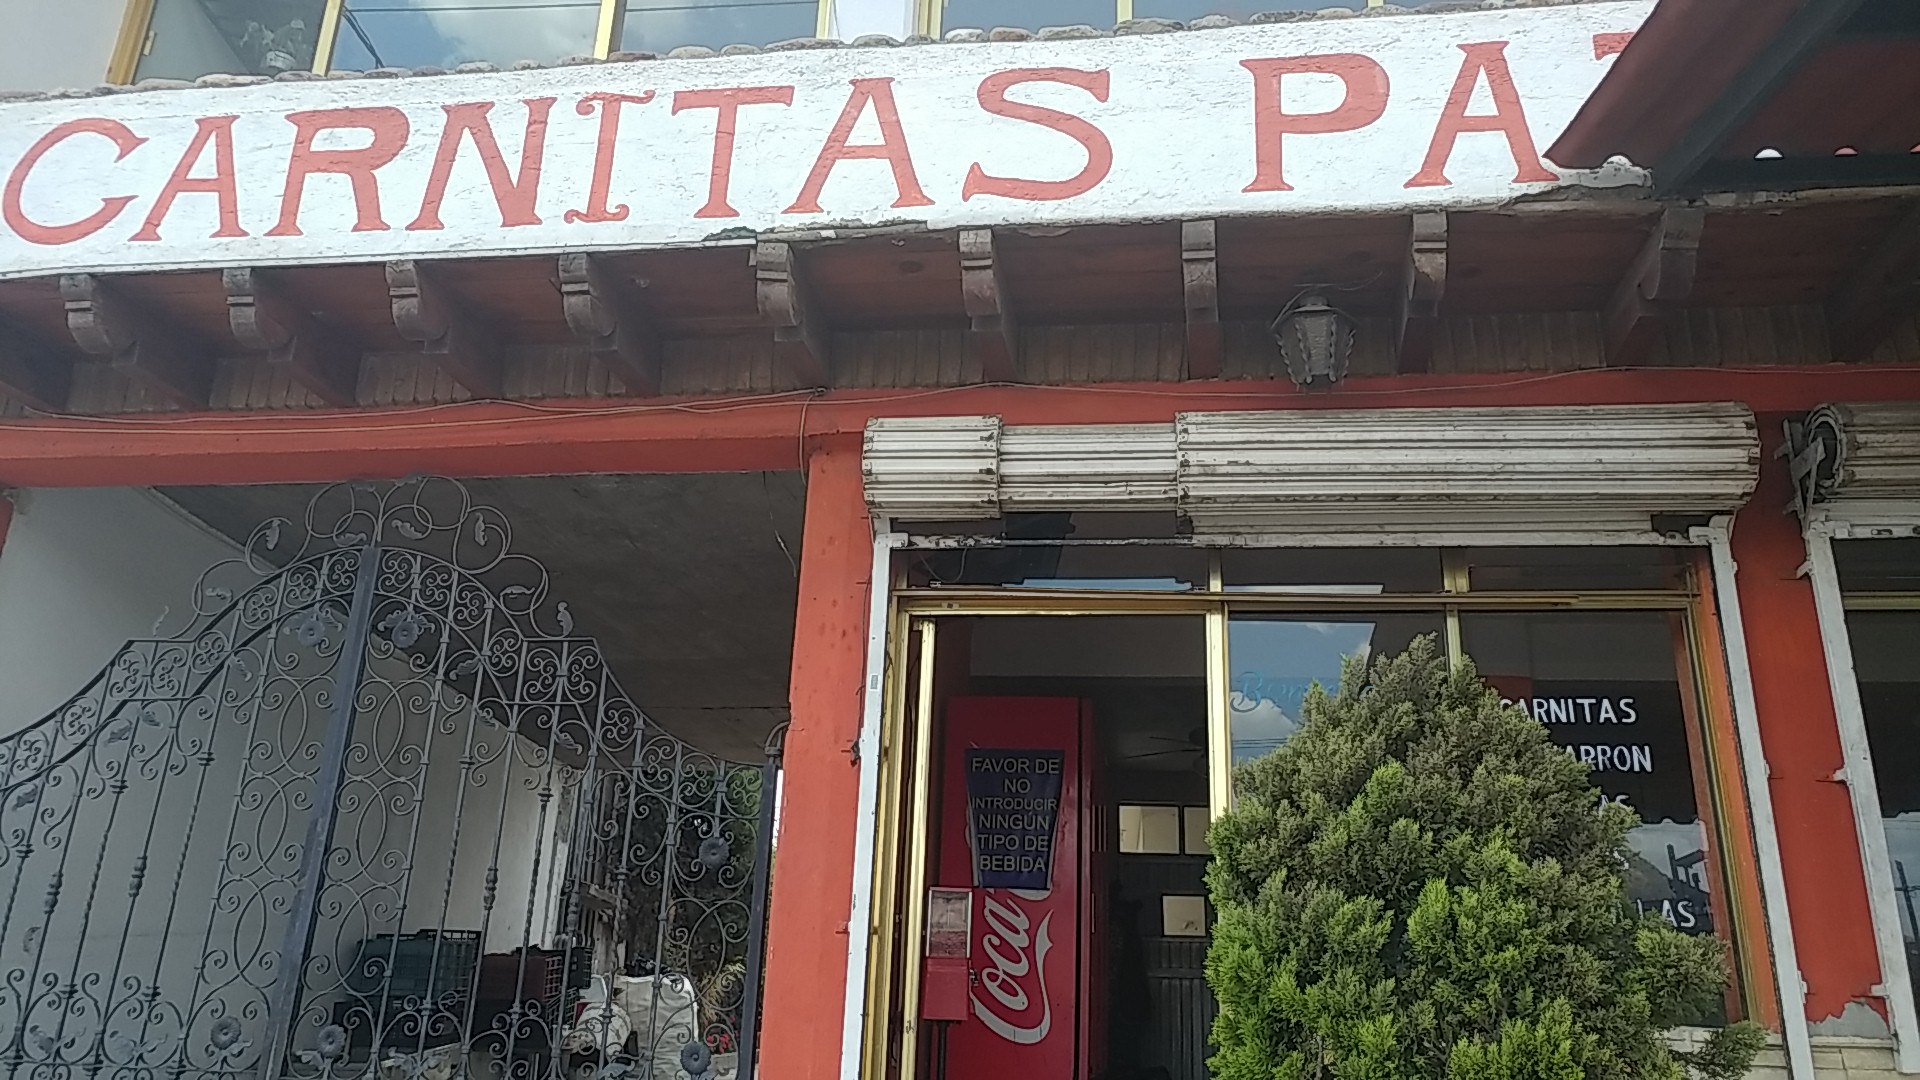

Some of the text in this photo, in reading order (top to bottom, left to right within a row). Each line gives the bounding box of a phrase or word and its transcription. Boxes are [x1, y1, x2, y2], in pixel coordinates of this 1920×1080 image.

[4, 31, 1632, 245] CARNITAS PA
[971, 757, 1060, 774] FAVOR DE
[1003, 778, 1032, 794] NO
[972, 797, 1058, 811] INTRODUCIR
[978, 811, 1050, 831] NINGÚN
[977, 834, 1049, 851] TIPO DE
[979, 855, 1047, 872] BEBIDA
